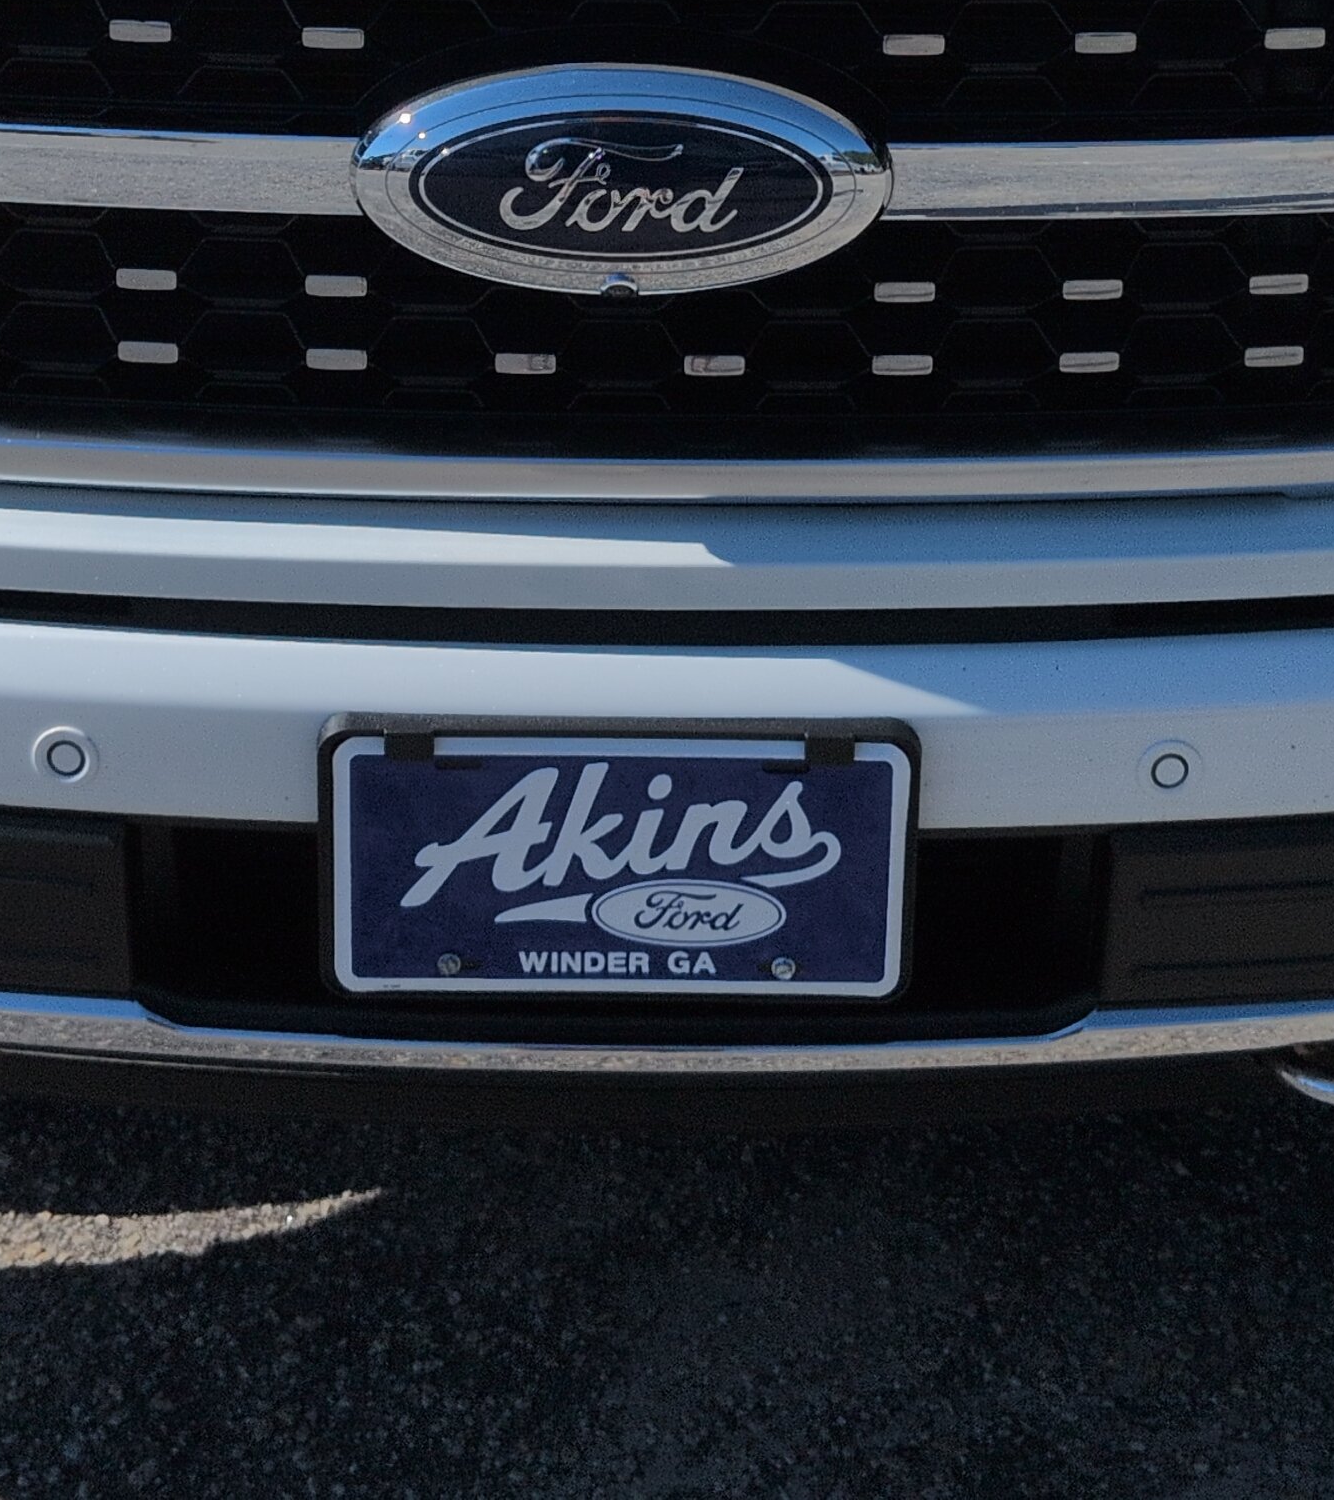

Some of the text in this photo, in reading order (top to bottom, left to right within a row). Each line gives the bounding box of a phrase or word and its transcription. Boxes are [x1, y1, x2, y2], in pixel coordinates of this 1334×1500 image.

[499, 136, 745, 233] Ford
[400, 761, 842, 908] Akins
[633, 890, 745, 931] Ford
[518, 951, 717, 975] WINDER GA
